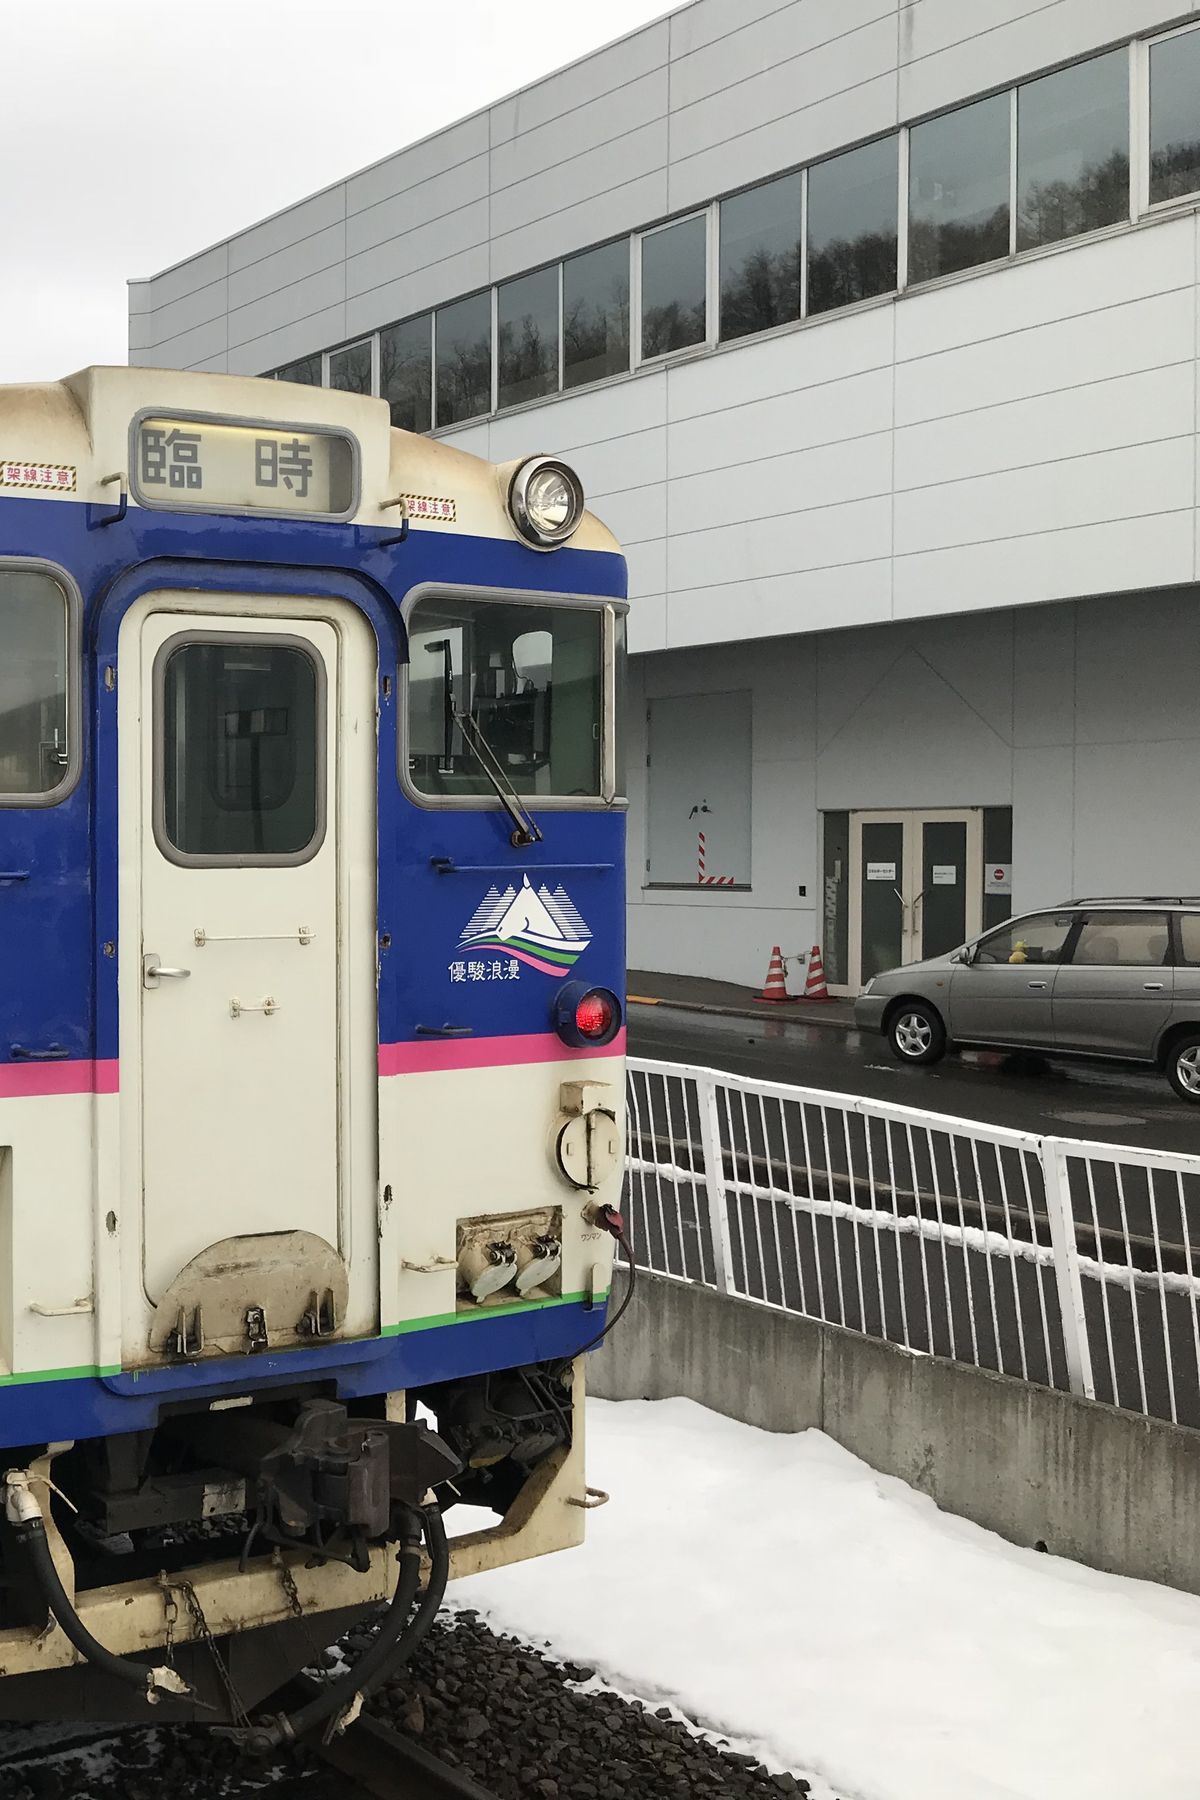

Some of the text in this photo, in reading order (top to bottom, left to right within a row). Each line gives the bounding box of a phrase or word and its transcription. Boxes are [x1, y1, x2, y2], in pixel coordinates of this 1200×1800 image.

[141, 428, 313, 498] 臨時
[6, 467, 70, 485] 架線注意
[447, 959, 521, 983] 優駿浪漫
[580, 1232, 602, 1242] ワンマン
